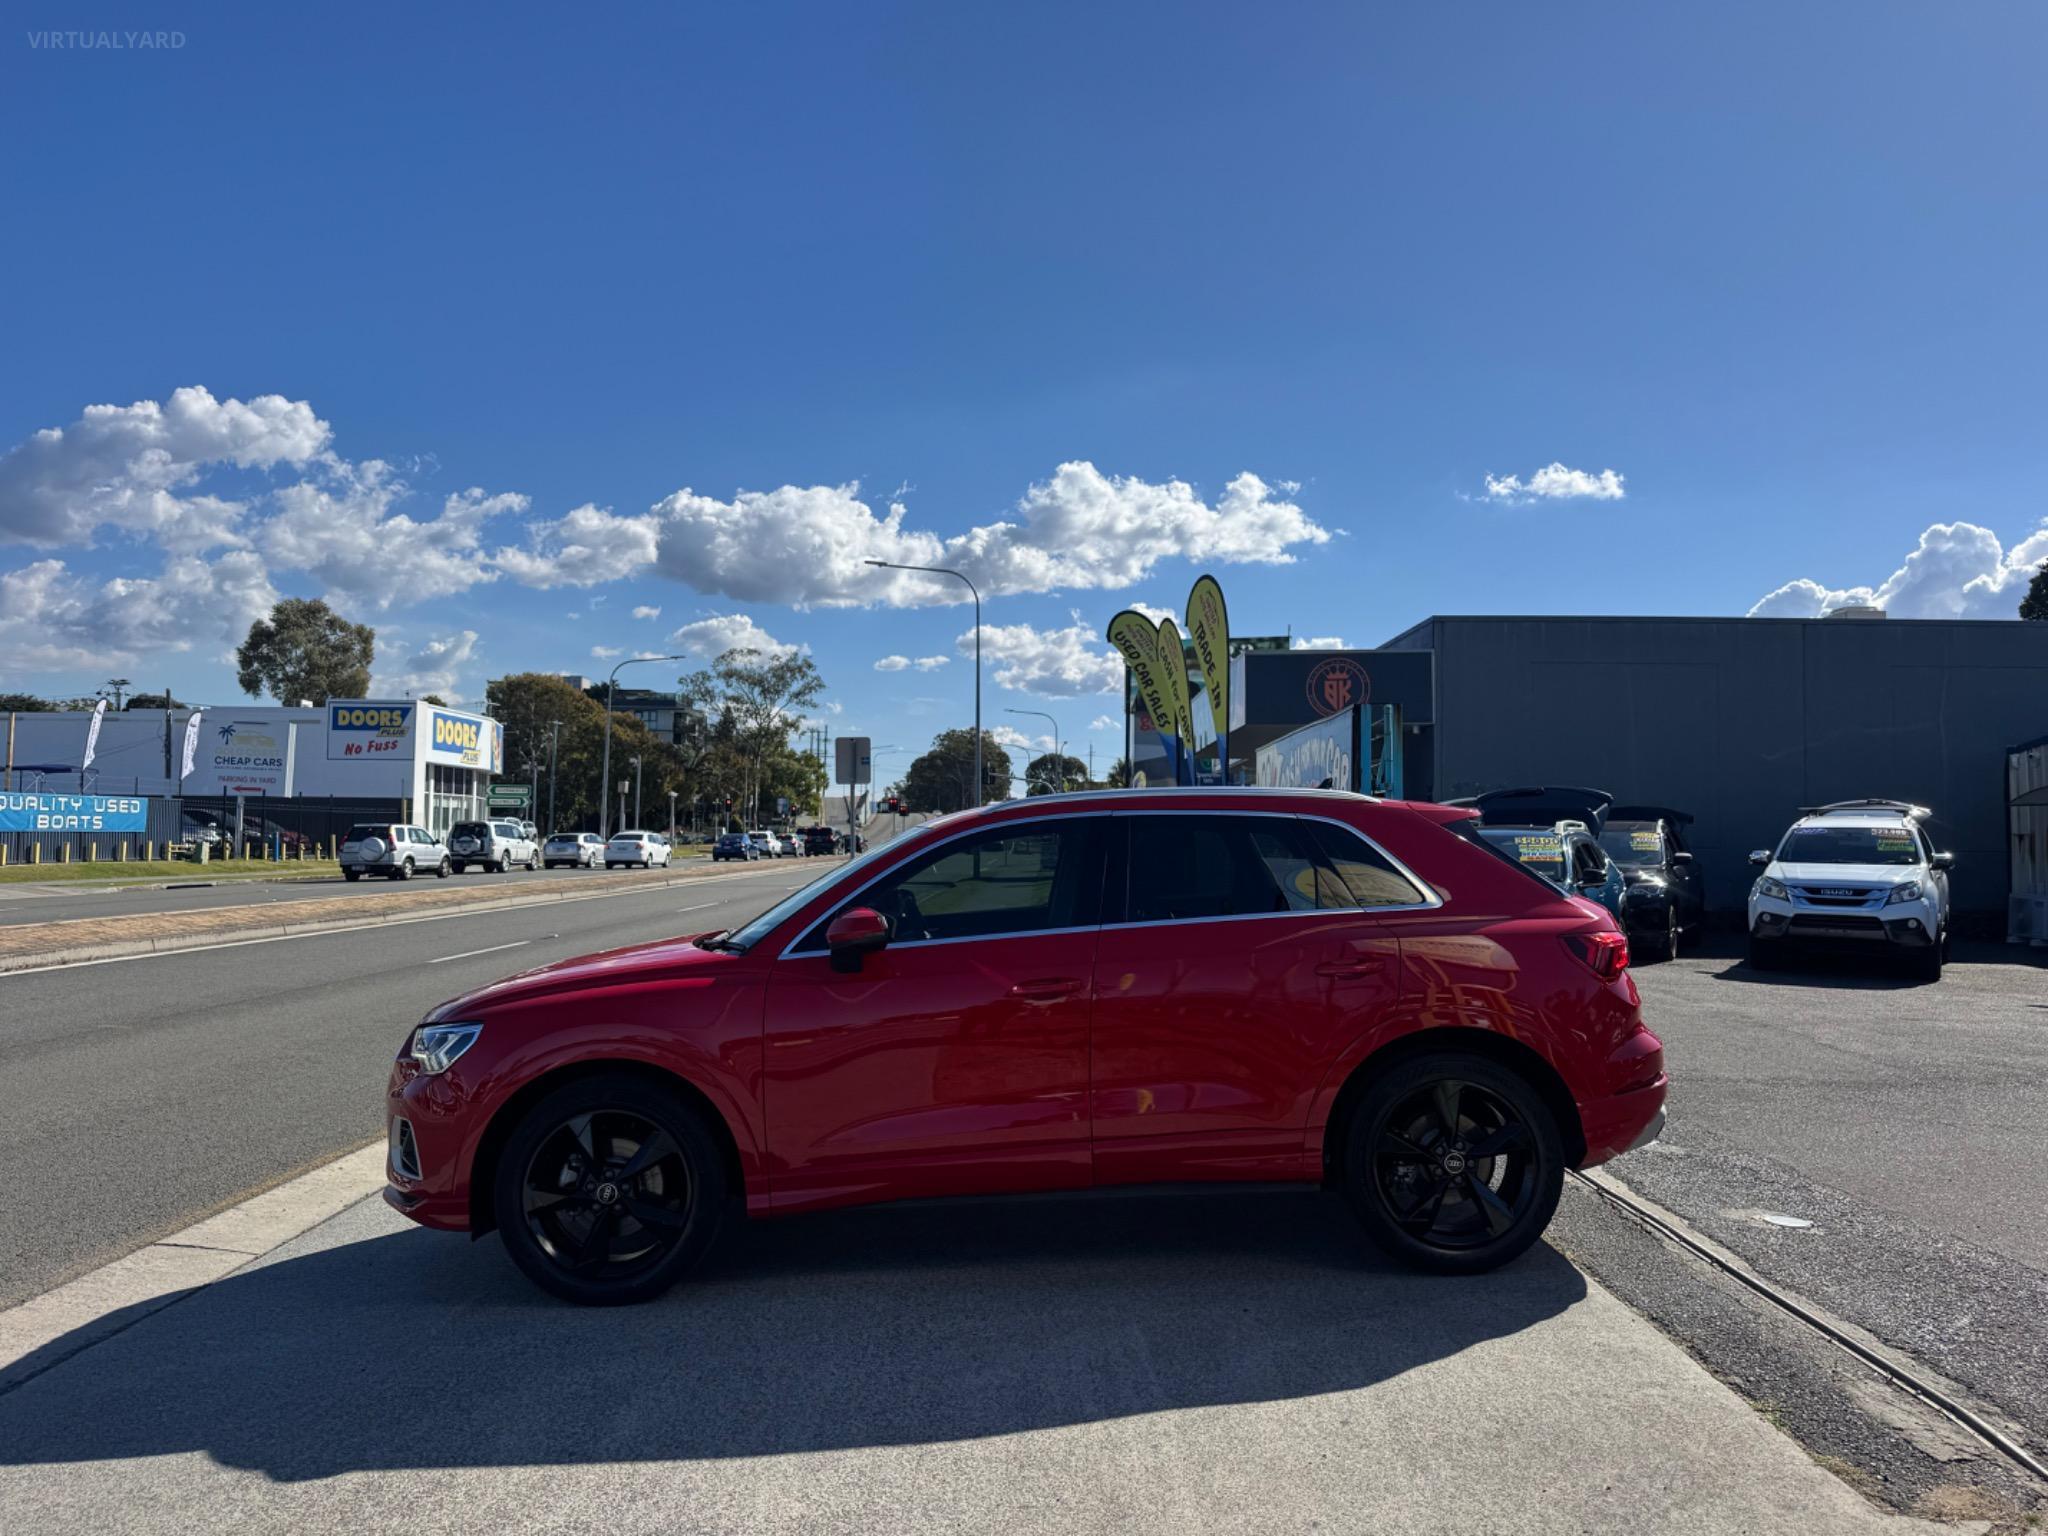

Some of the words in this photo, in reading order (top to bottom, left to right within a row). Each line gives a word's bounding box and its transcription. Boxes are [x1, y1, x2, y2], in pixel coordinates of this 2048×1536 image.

[1160, 646, 1174, 680] CASH
[1114, 631, 1140, 660] USED
[1134, 662, 1154, 689] CAR
[1146, 690, 1170, 728] SALES
[338, 709, 402, 727] DOORS
[436, 718, 477, 749] DOORS
[345, 743, 362, 755] No
[367, 739, 398, 753] Fuss
[214, 756, 251, 766] CHEAP
[253, 758, 283, 767] CARS
[462, 751, 479, 762] PLUS
[94, 799, 140, 813] USED
[37, 814, 103, 829] BOATS
